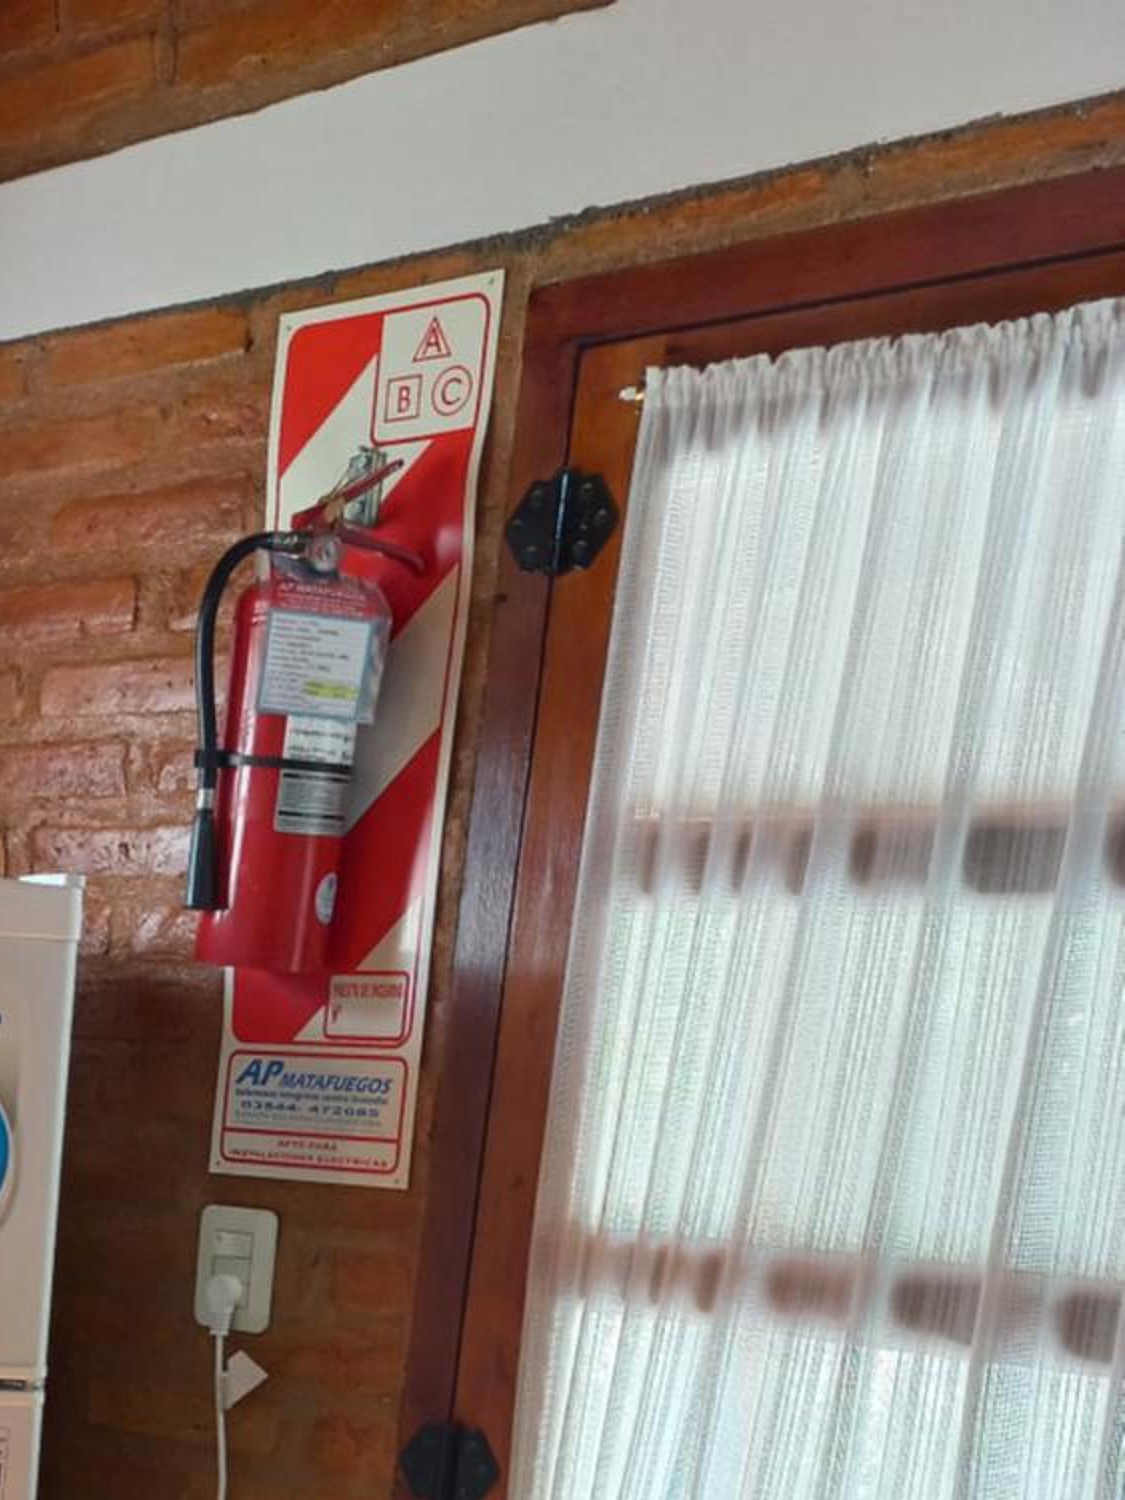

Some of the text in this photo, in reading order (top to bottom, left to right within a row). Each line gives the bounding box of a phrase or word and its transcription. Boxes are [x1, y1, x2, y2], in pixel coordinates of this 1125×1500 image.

[424, 327, 443, 354] A
[398, 376, 464, 413] B C
[235, 1058, 393, 1095] AP MATAFUEGOS
